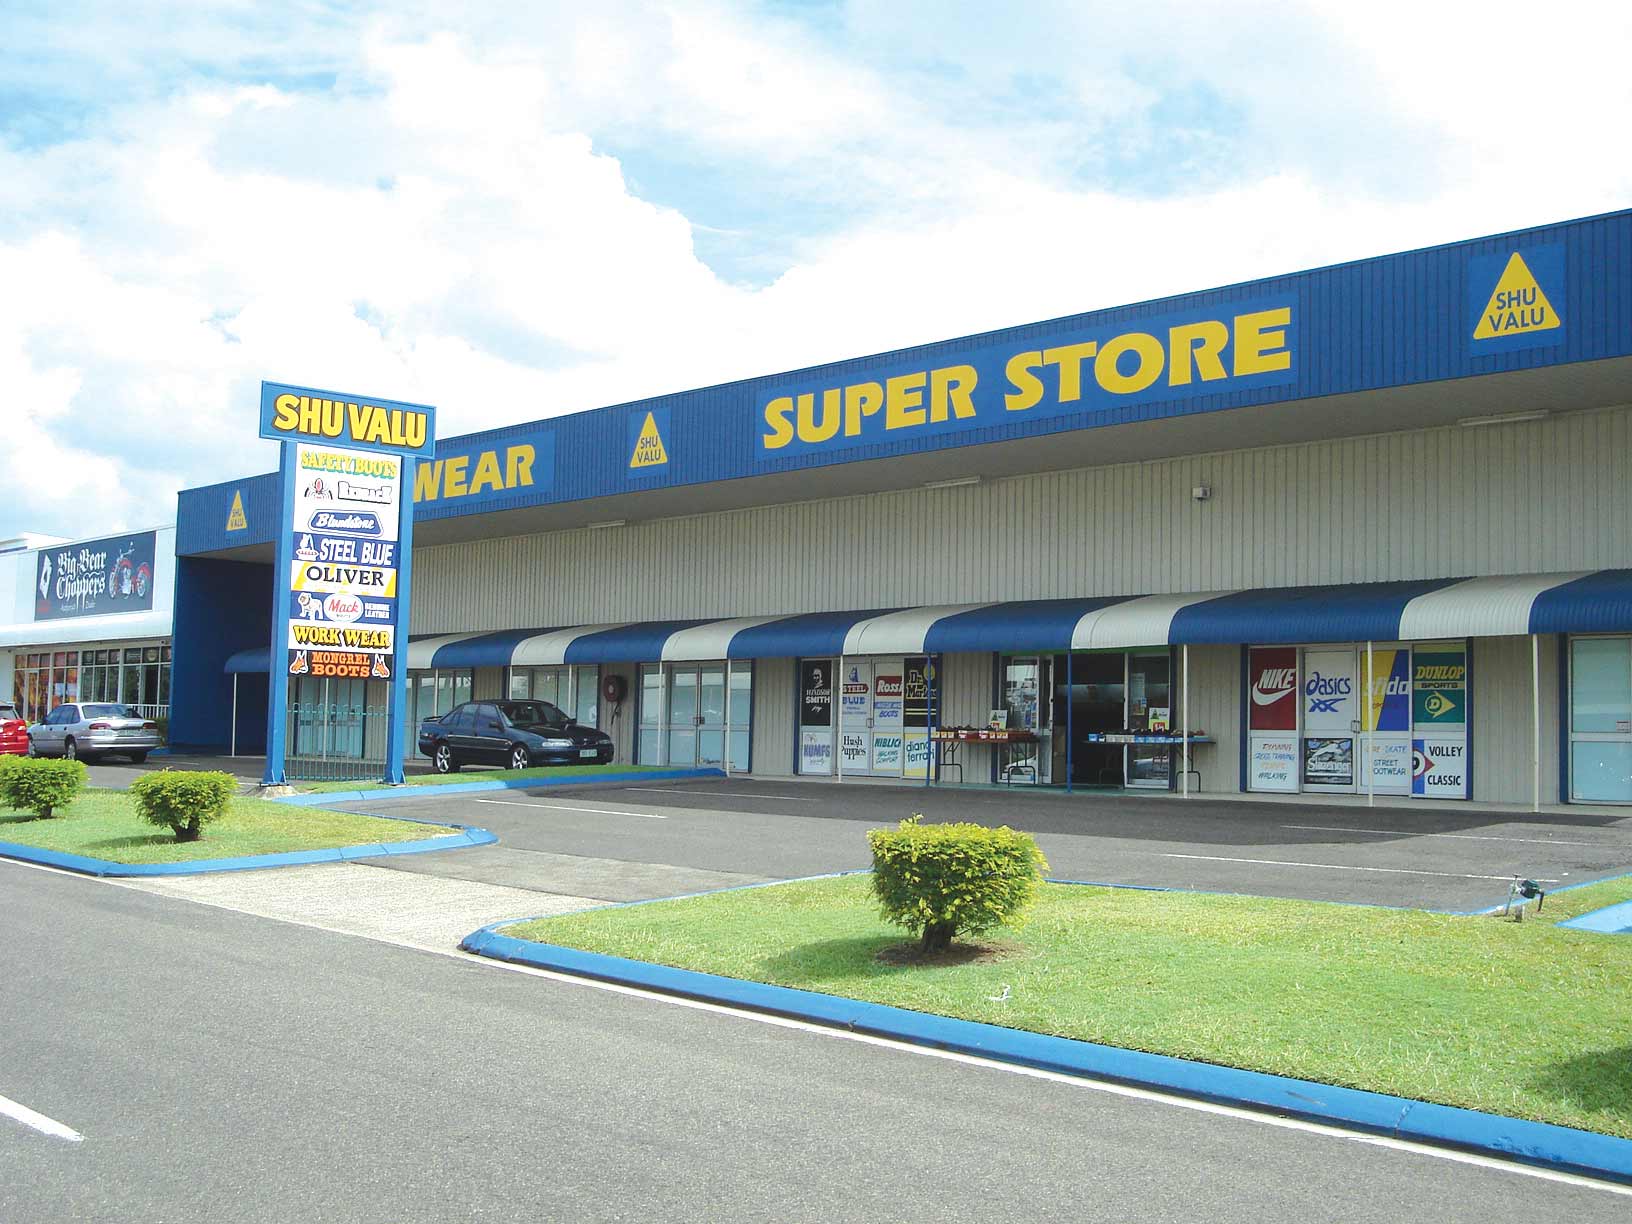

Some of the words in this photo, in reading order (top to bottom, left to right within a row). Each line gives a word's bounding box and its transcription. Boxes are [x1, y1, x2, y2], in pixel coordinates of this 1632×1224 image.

[1496, 287, 1536, 310] SHU
[1489, 306, 1544, 332] VALU
[763, 364, 978, 449] SUPER
[1005, 307, 1291, 411] STORE
[274, 394, 345, 437] SHU
[347, 403, 427, 448] VALU
[640, 434, 658, 449] SHU
[302, 450, 352, 475] SAFETY
[637, 448, 661, 463] VALU
[413, 444, 535, 503] WEAR
[320, 538, 357, 562] STEEL
[361, 541, 394, 566] BLUE
[306, 565, 384, 586] OLIVER
[328, 599, 359, 613] Mack
[293, 625, 342, 647] WORK
[343, 628, 391, 649] WEAR
[311, 651, 370, 665] MONGREL
[311, 663, 370, 678] BOOTS
[1415, 665, 1464, 680] DUNLOP
[1258, 668, 1297, 689] NIKE
[805, 696, 831, 704] SMITH
[843, 735, 863, 746] Hush
[874, 737, 902, 748] NIBLIC
[907, 749, 935, 762] ferrai
[1428, 745, 1463, 758] VOLLEY
[1372, 767, 1407, 776] OOTWEAR
[1427, 774, 1462, 787] CLASSIC
